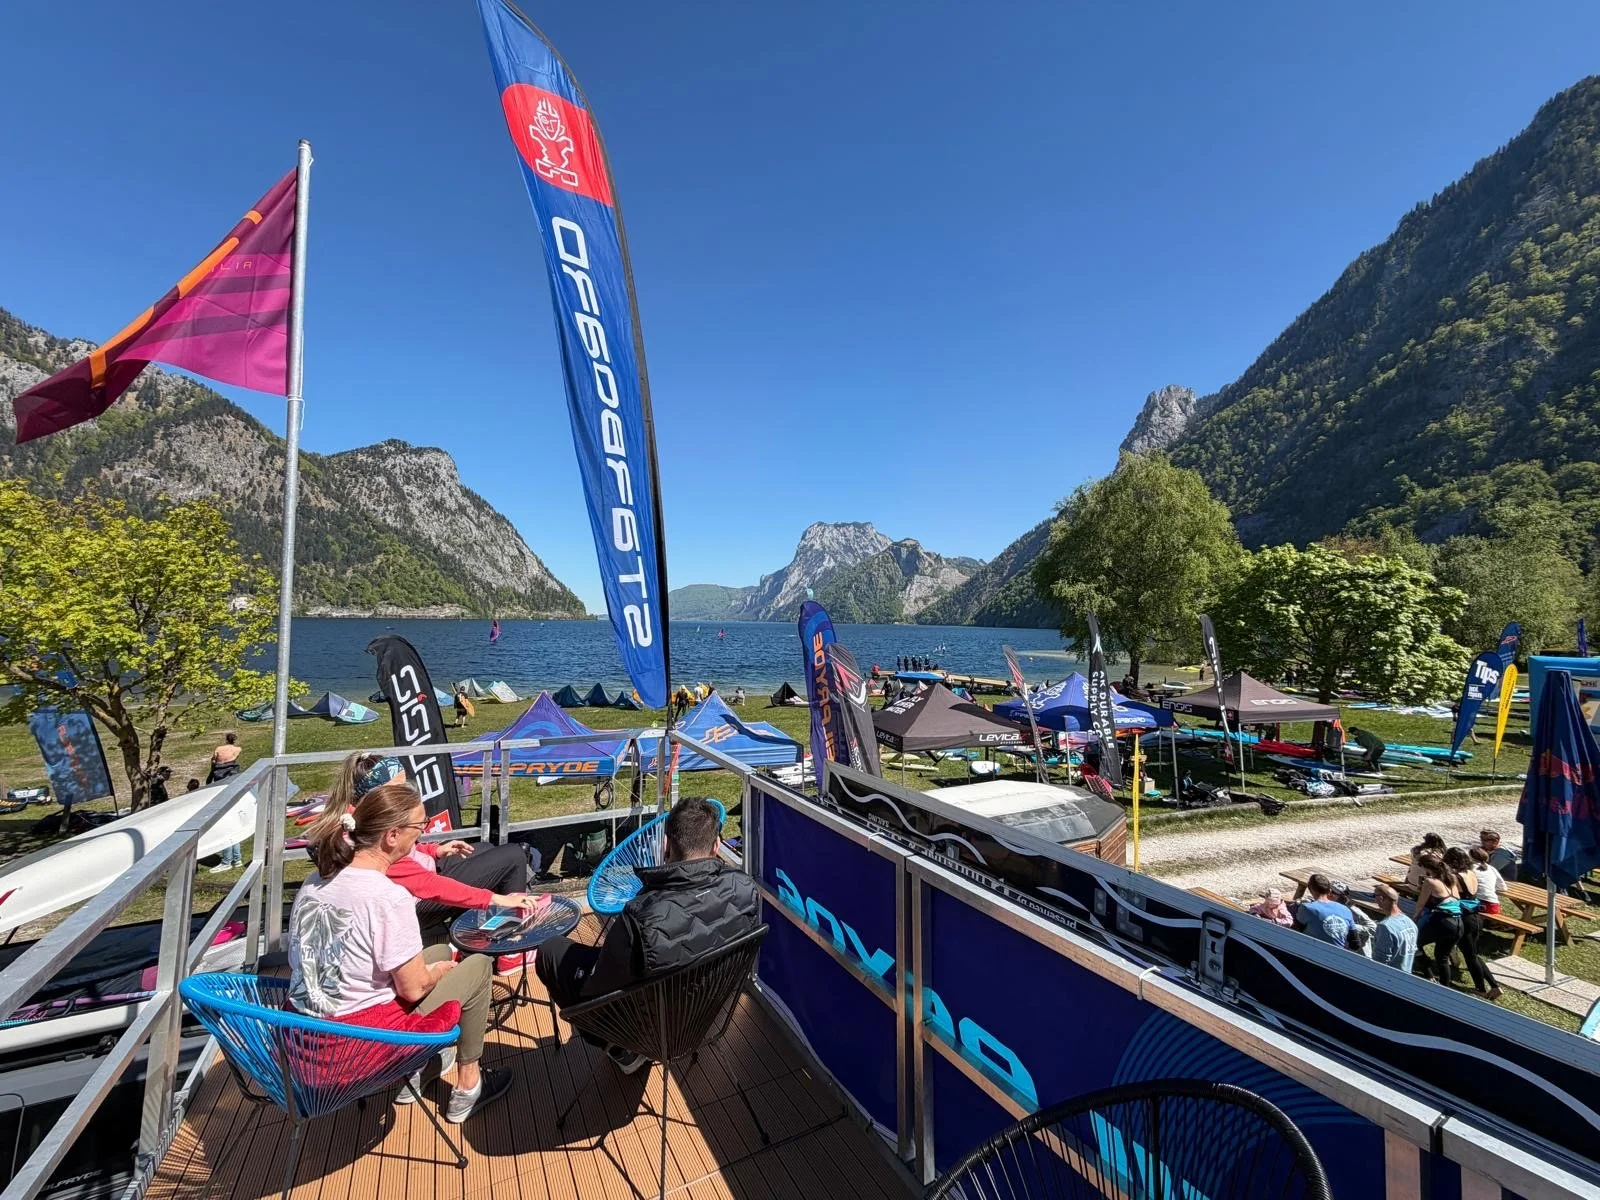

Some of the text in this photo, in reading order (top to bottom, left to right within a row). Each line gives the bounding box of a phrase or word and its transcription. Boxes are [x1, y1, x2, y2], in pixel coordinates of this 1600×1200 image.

[1090, 671, 1099, 715] SUPPLY
[1475, 660, 1500, 684] Tips
[1099, 693, 1115, 749] DURABLE
